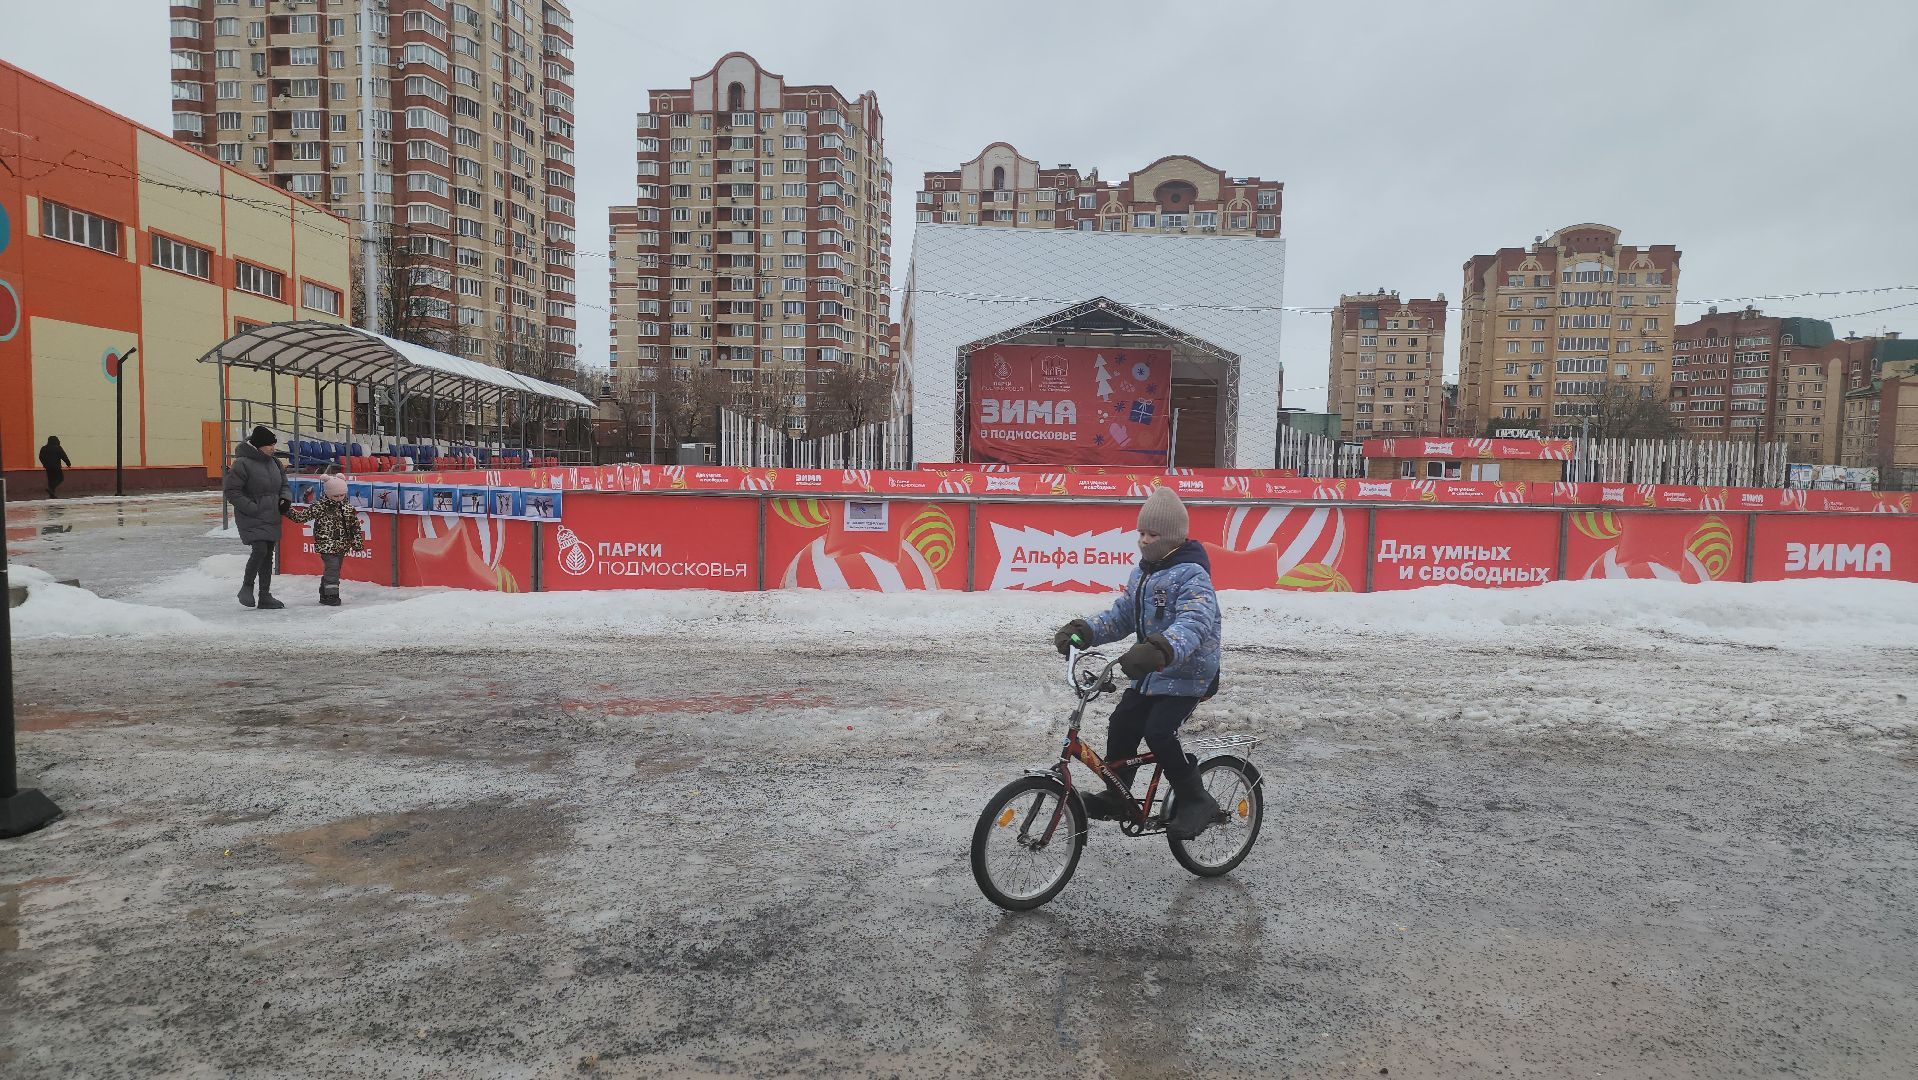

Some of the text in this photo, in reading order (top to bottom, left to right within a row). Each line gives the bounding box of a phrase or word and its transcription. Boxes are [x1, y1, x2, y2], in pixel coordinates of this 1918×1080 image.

[980, 399, 1077, 425] ЗИМА
[990, 430, 1077, 441] ПОДМОСКОВЬЕ
[1495, 428, 1541, 439] ПРОКАТ
[795, 474, 822, 482] ЗИМА
[1178, 480, 1204, 489] ЗИМА
[599, 541, 662, 558] ПАРКИ
[1011, 545, 1135, 569] Альфа Банк
[1378, 540, 1511, 563] Для умных
[1785, 542, 1891, 573] ЗИМА
[598, 561, 747, 578] ПОДМОСКОВЬЯ
[1399, 562, 1551, 587] и свободных
